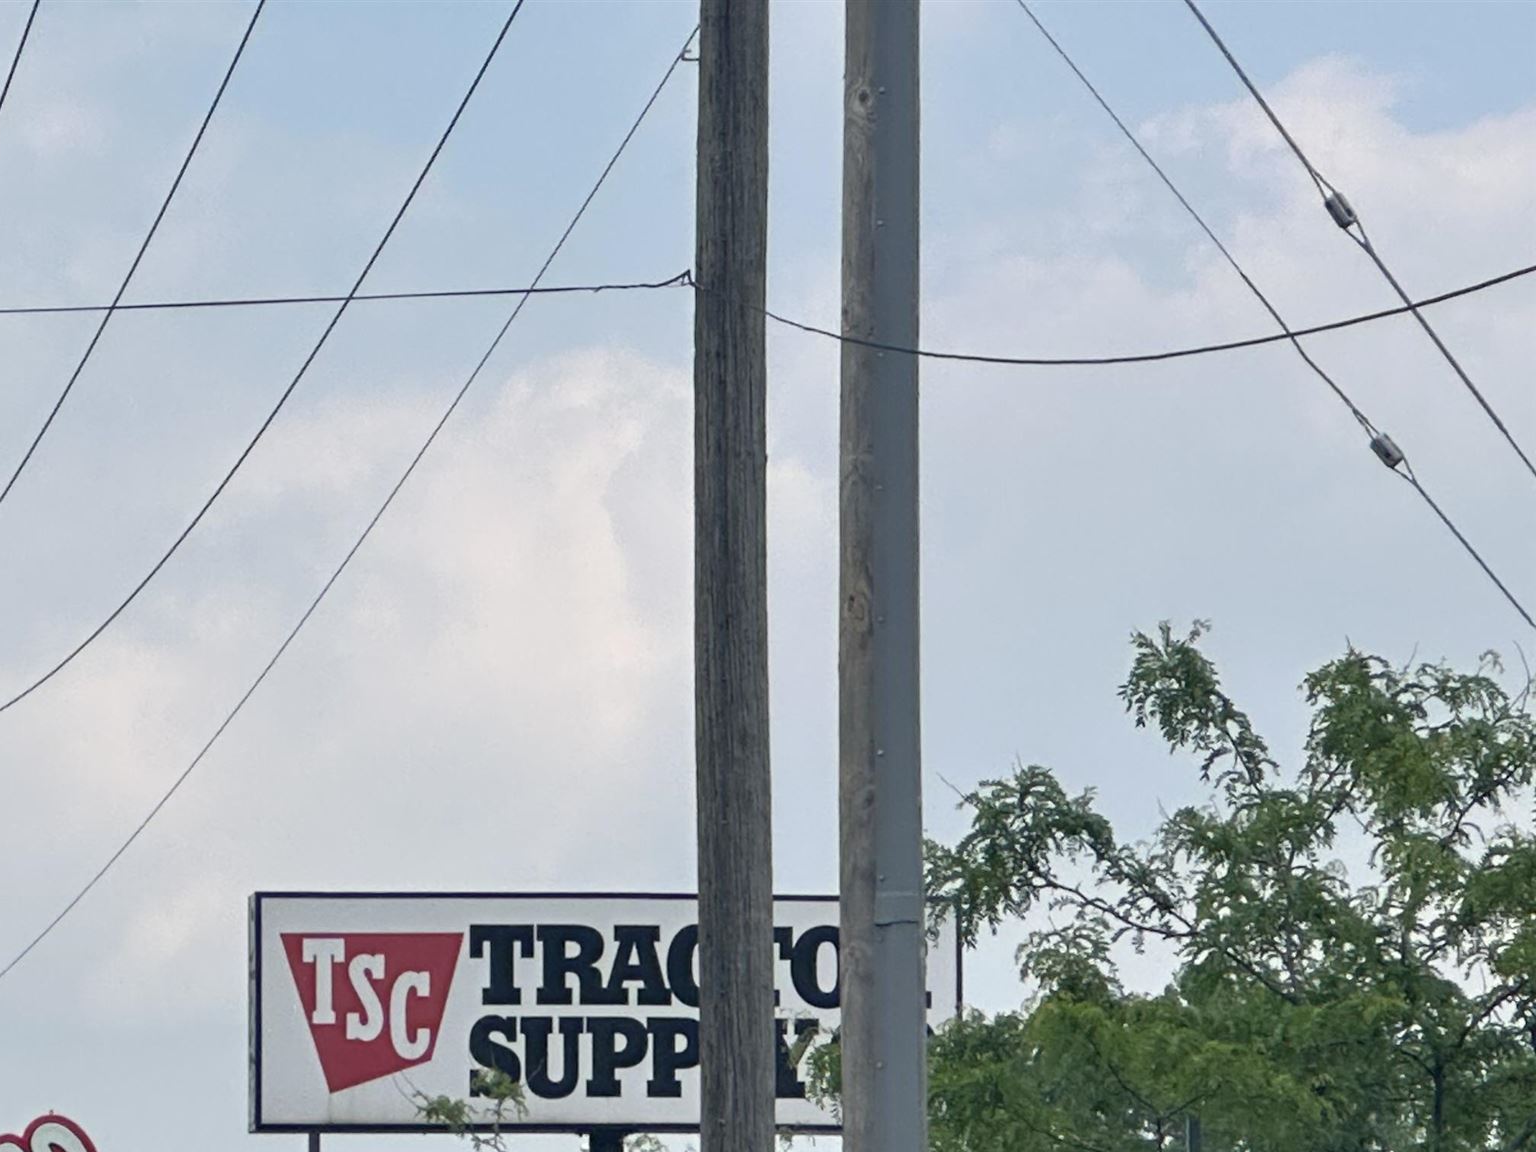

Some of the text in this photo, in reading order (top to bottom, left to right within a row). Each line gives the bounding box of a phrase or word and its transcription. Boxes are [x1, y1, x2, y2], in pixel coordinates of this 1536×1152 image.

[302, 937, 431, 1060] TSC
[469, 924, 932, 1009] TRACO
[469, 1016, 820, 1099] SUPPY
